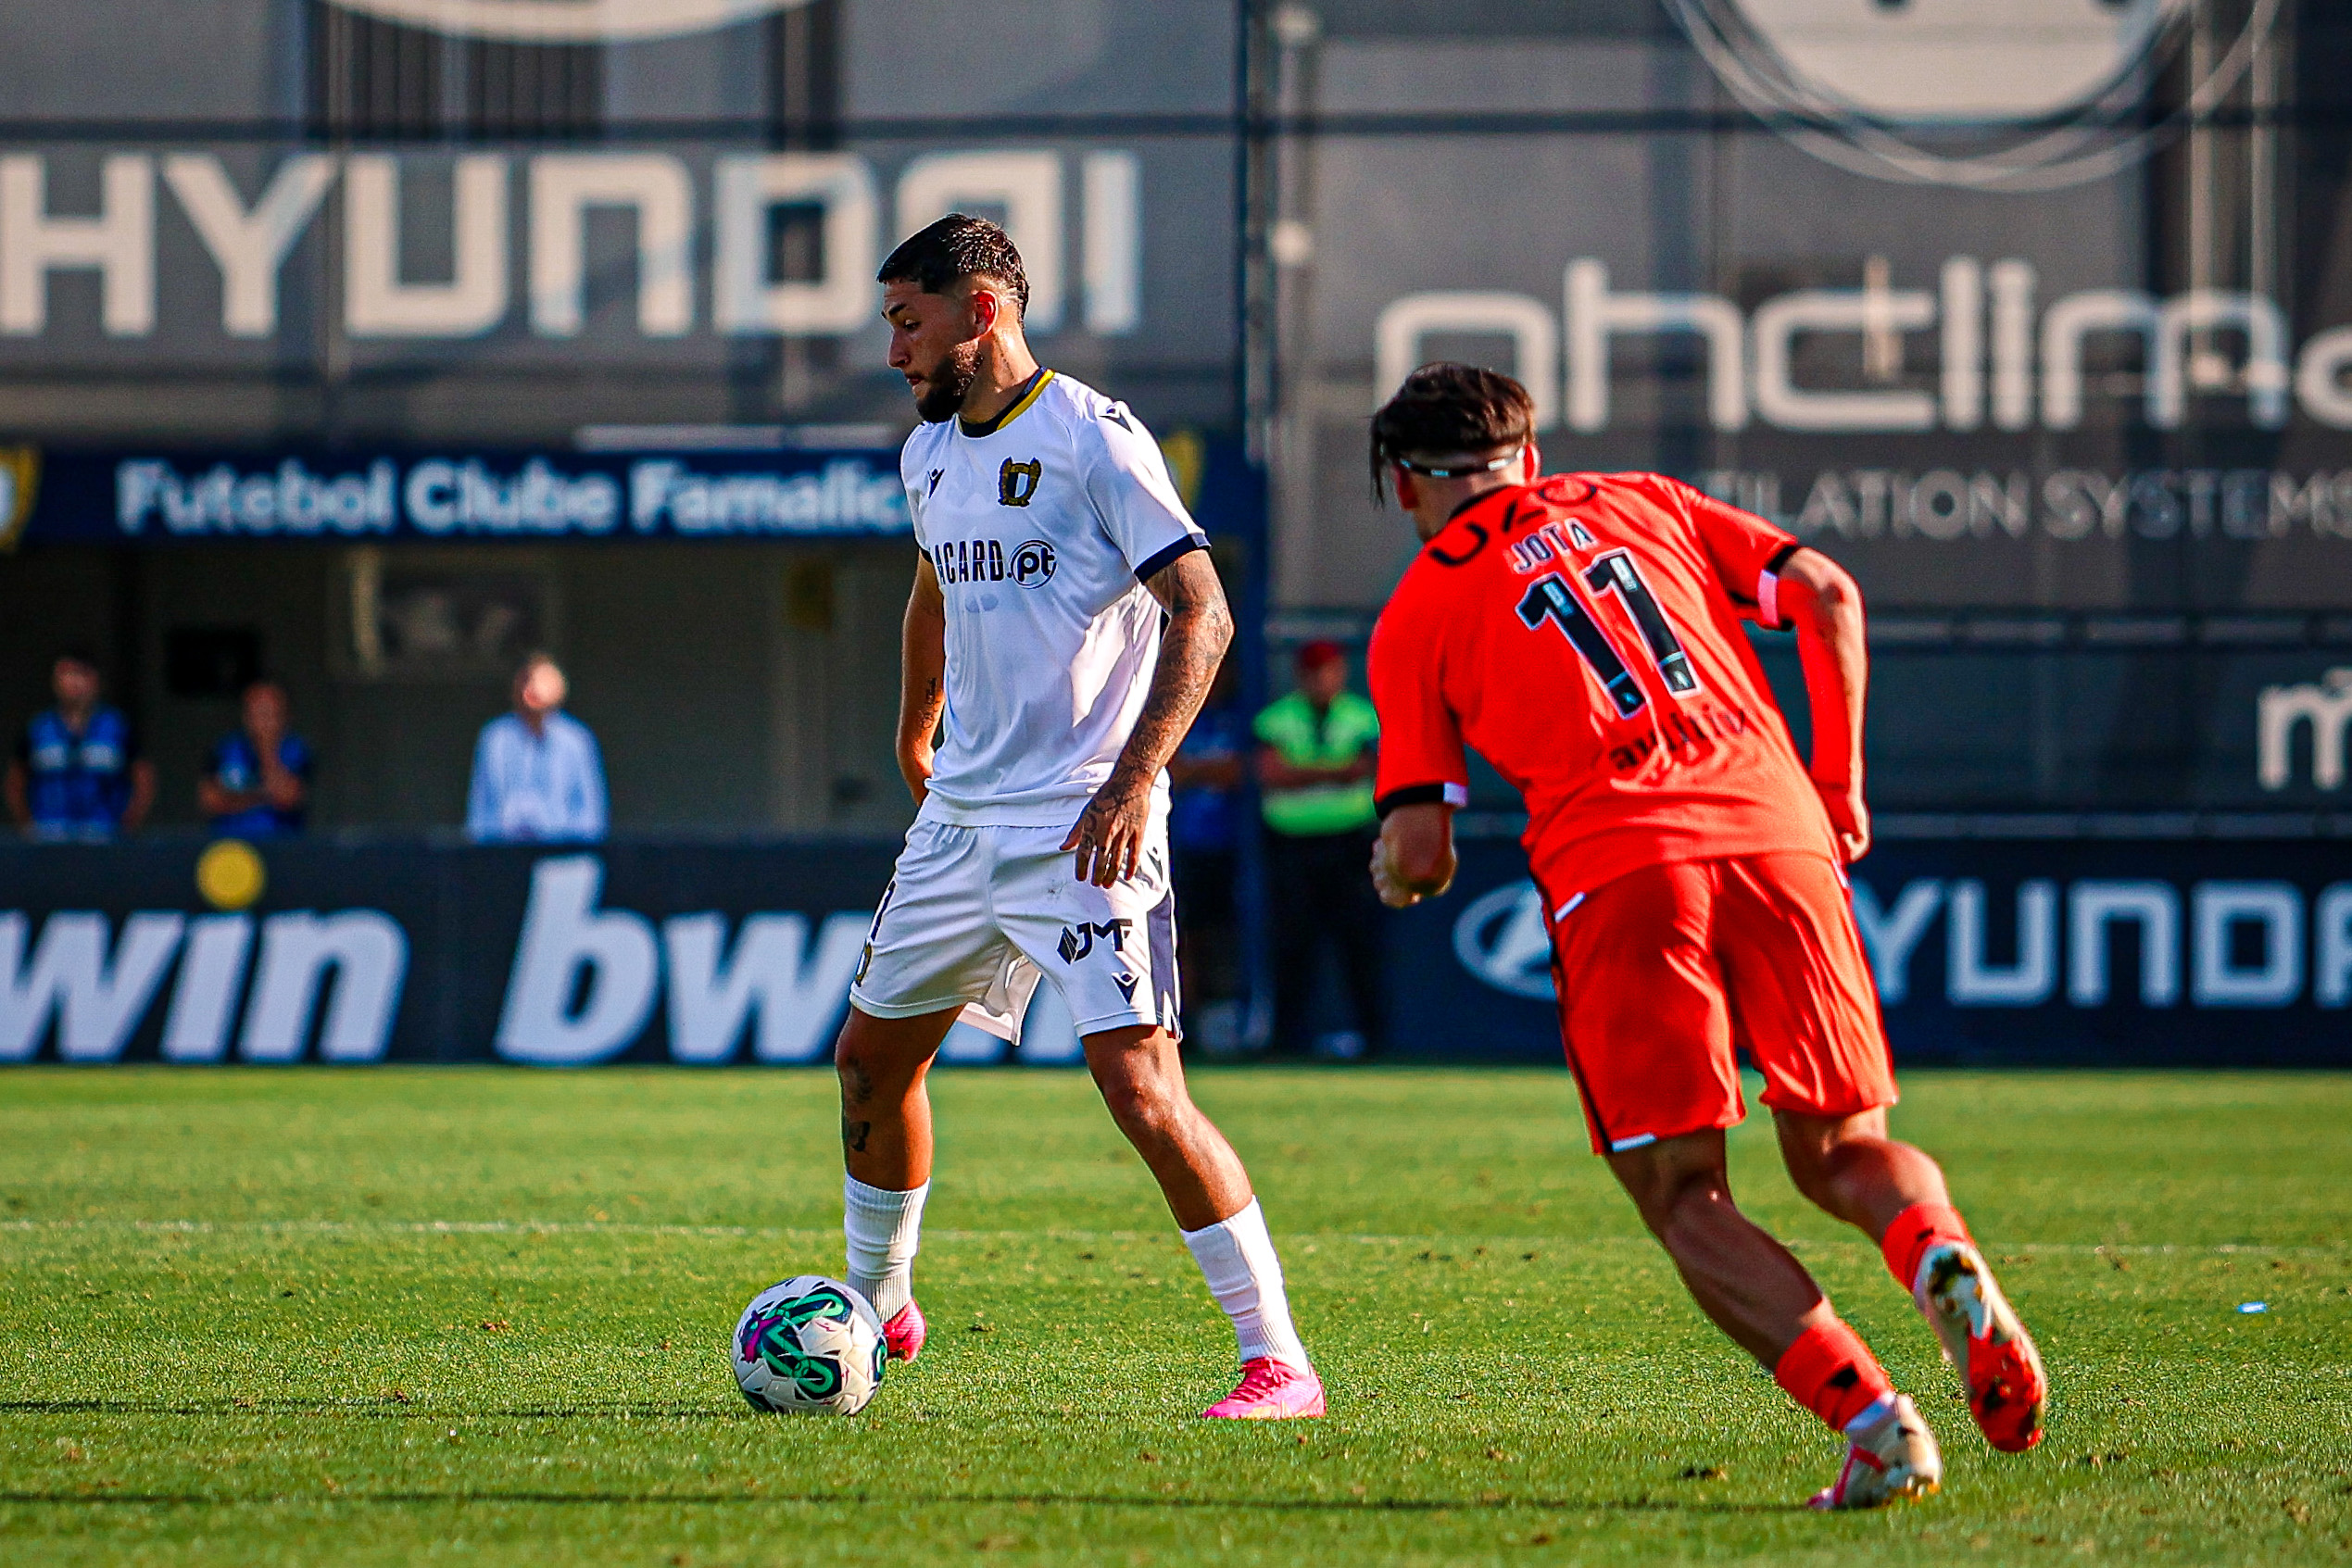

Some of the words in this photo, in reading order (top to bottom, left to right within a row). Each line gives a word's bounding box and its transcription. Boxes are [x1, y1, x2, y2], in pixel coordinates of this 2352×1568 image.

[0, 151, 1140, 336] HYUNDAI
[113, 458, 396, 536] Futebol
[404, 458, 623, 536] Clube
[629, 458, 912, 536] Famalic
[1511, 517, 1598, 574] JOTA
[1704, 469, 2031, 539] TILATION
[929, 539, 1058, 590] ACARD.pt
[1514, 546, 1702, 721] 11
[493, 852, 1082, 1064] bw
[1851, 877, 2352, 1008] YUND
